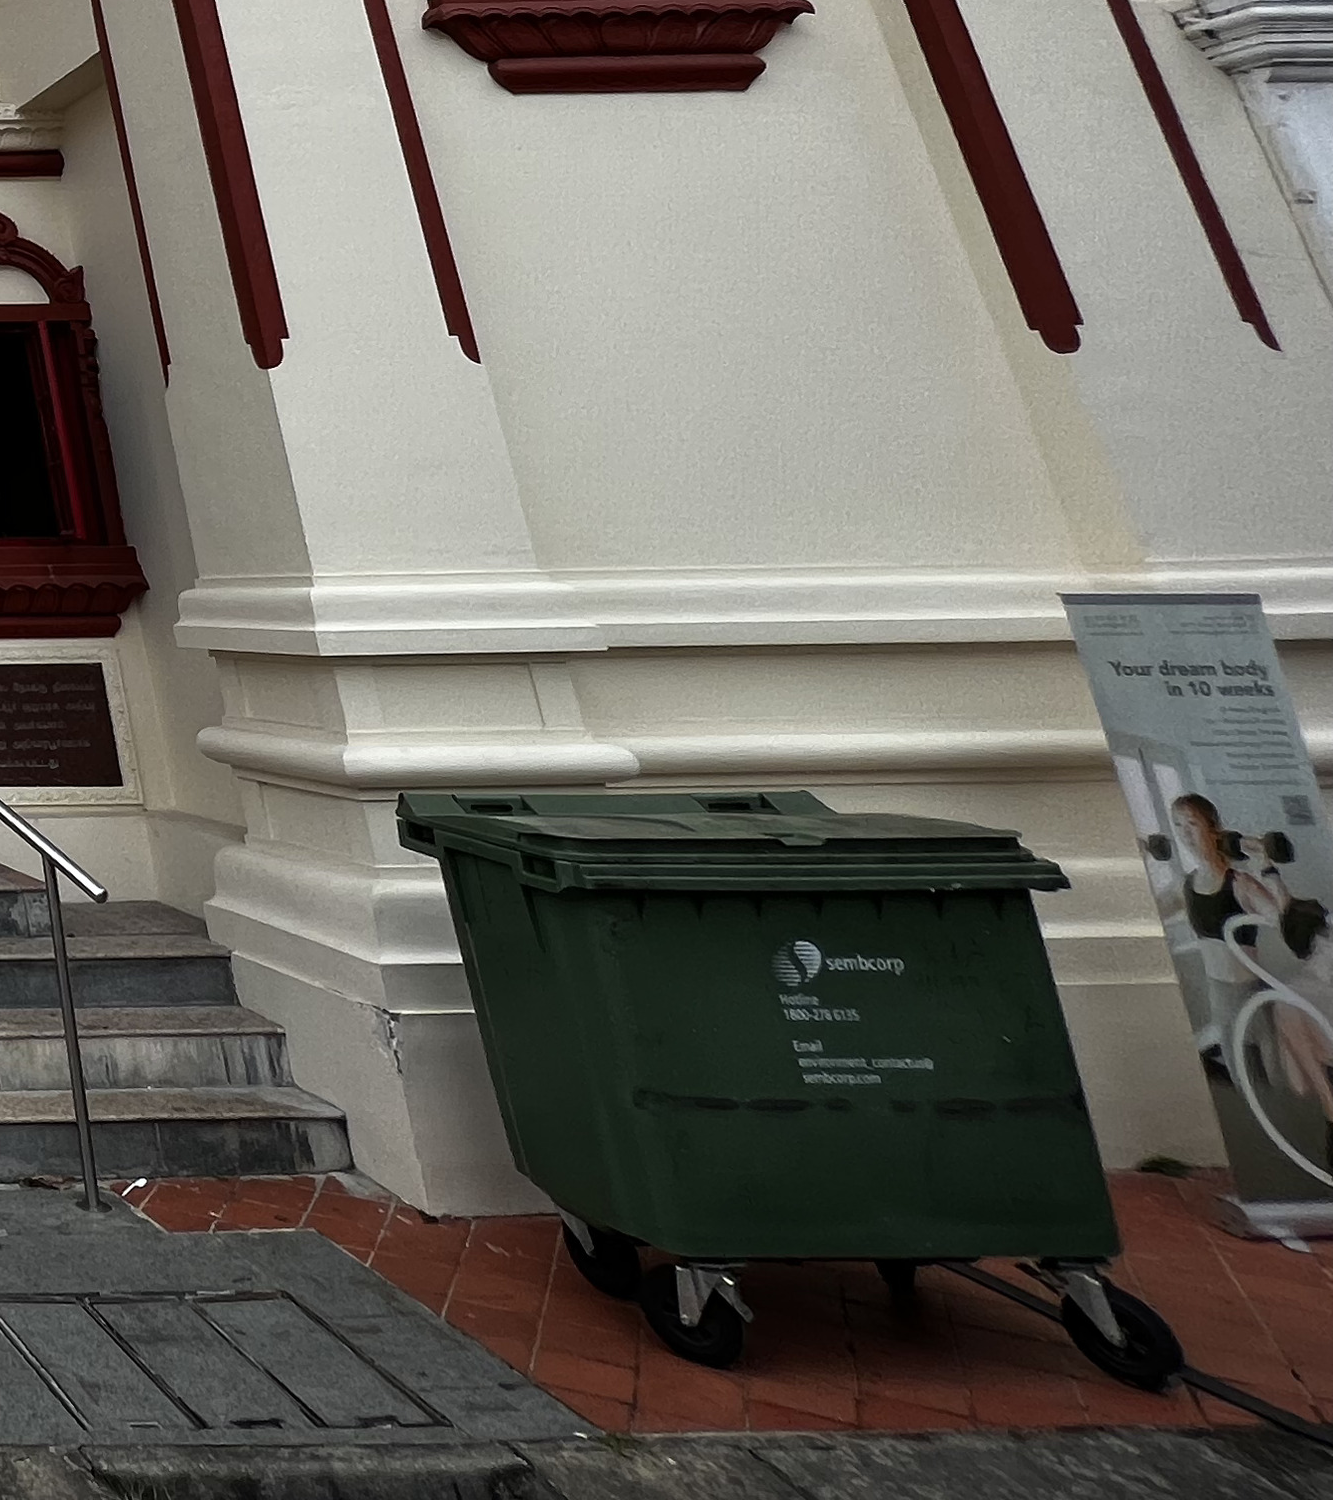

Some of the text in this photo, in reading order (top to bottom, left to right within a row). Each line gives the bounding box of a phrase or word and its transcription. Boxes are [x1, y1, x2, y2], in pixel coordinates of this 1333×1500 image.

[1108, 659, 1268, 681] Your dream body
[1166, 681, 1276, 698] in 10 weeks
[825, 954, 905, 976] sembcorp
[779, 994, 820, 1006] Hotline
[792, 1040, 824, 1052] Email
[802, 1072, 882, 1085] sembcorp.com
